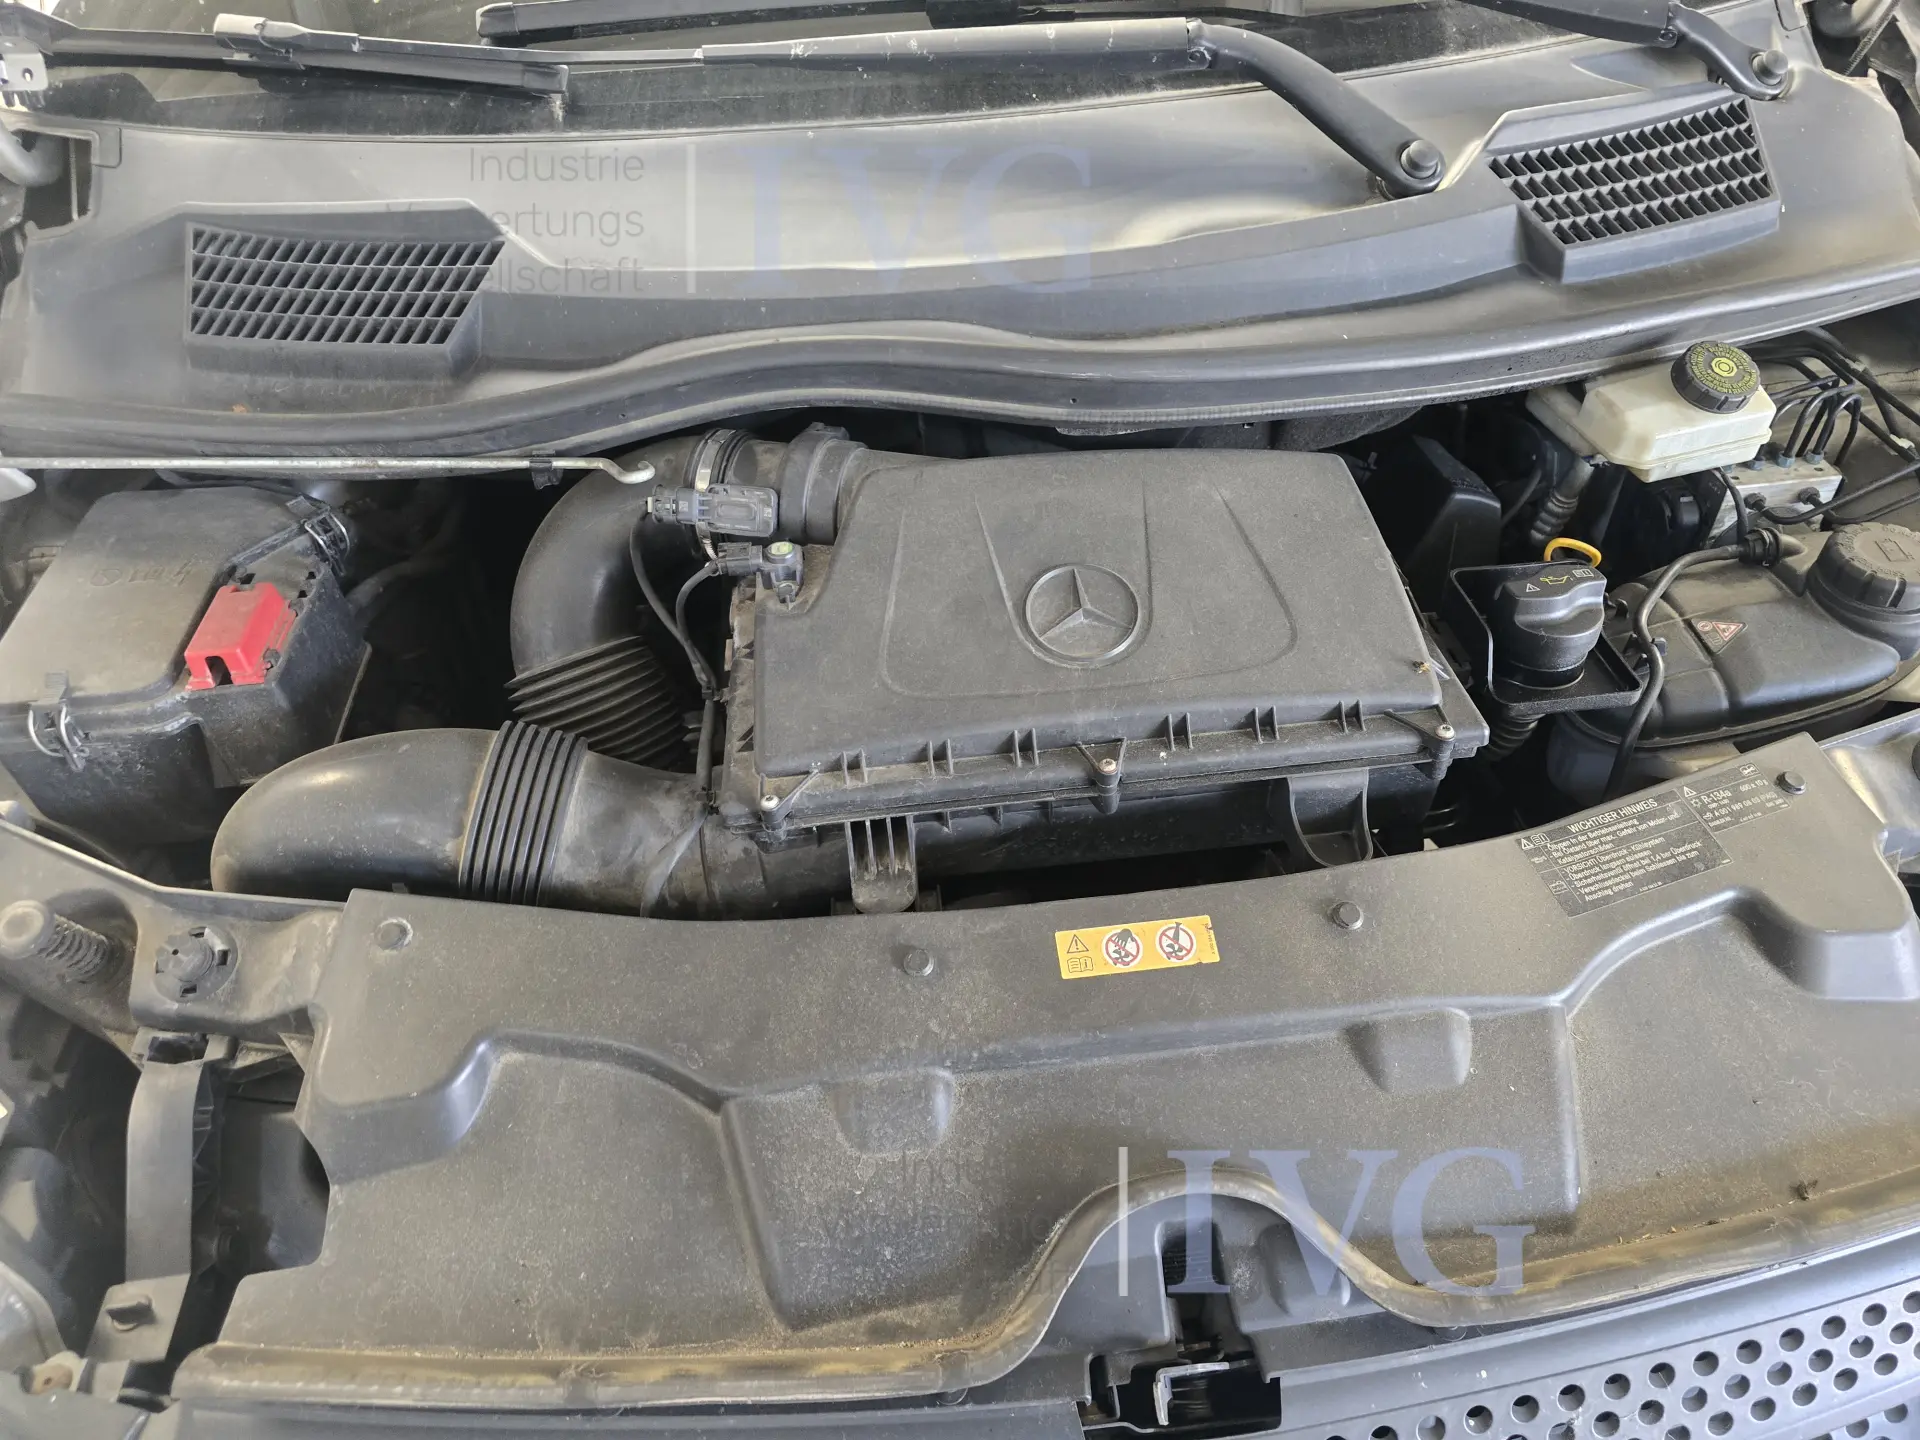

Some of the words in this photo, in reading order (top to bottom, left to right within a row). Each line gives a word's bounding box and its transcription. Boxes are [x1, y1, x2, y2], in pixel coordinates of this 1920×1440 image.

[1701, 790, 1732, 804] R-134a
[1568, 812, 1620, 833] WICHTIGER
[1618, 799, 1657, 817] HINWEIS
